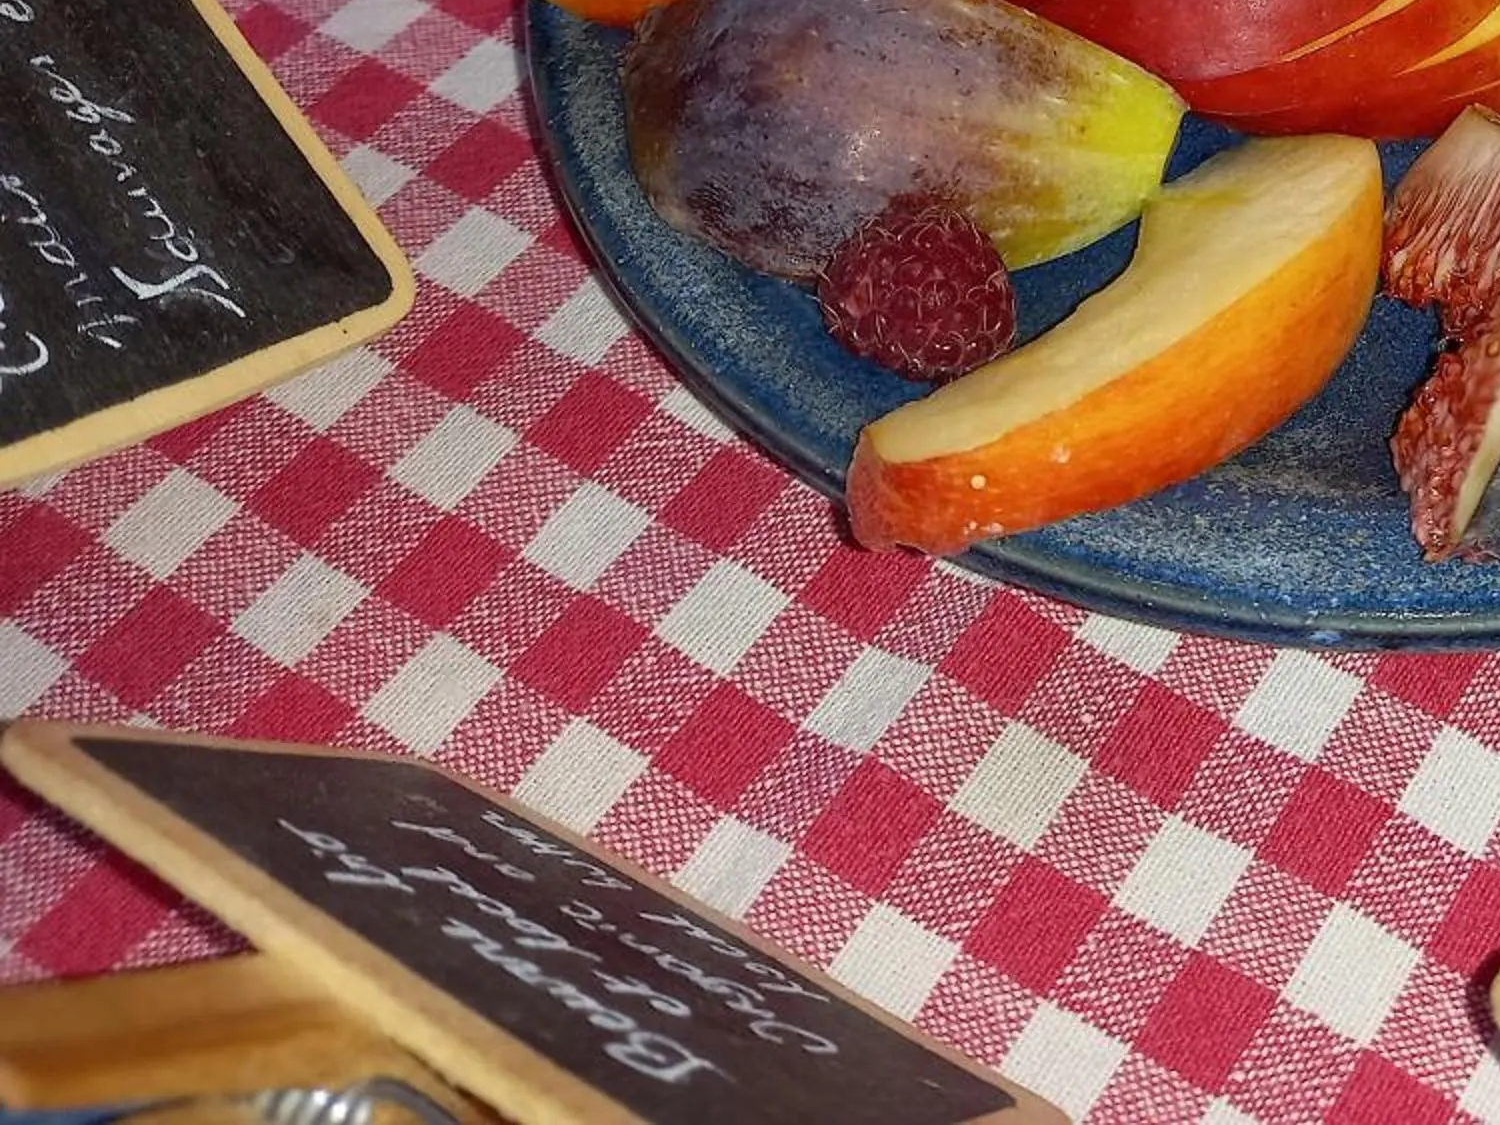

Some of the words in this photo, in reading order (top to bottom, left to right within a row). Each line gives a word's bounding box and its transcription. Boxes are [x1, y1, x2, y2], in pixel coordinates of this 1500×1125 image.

[277, 818, 416, 894] bio
[390, 820, 536, 881] and
[400, 866, 601, 962] local
[441, 917, 736, 1084] Beurre
[593, 969, 691, 1019] et
